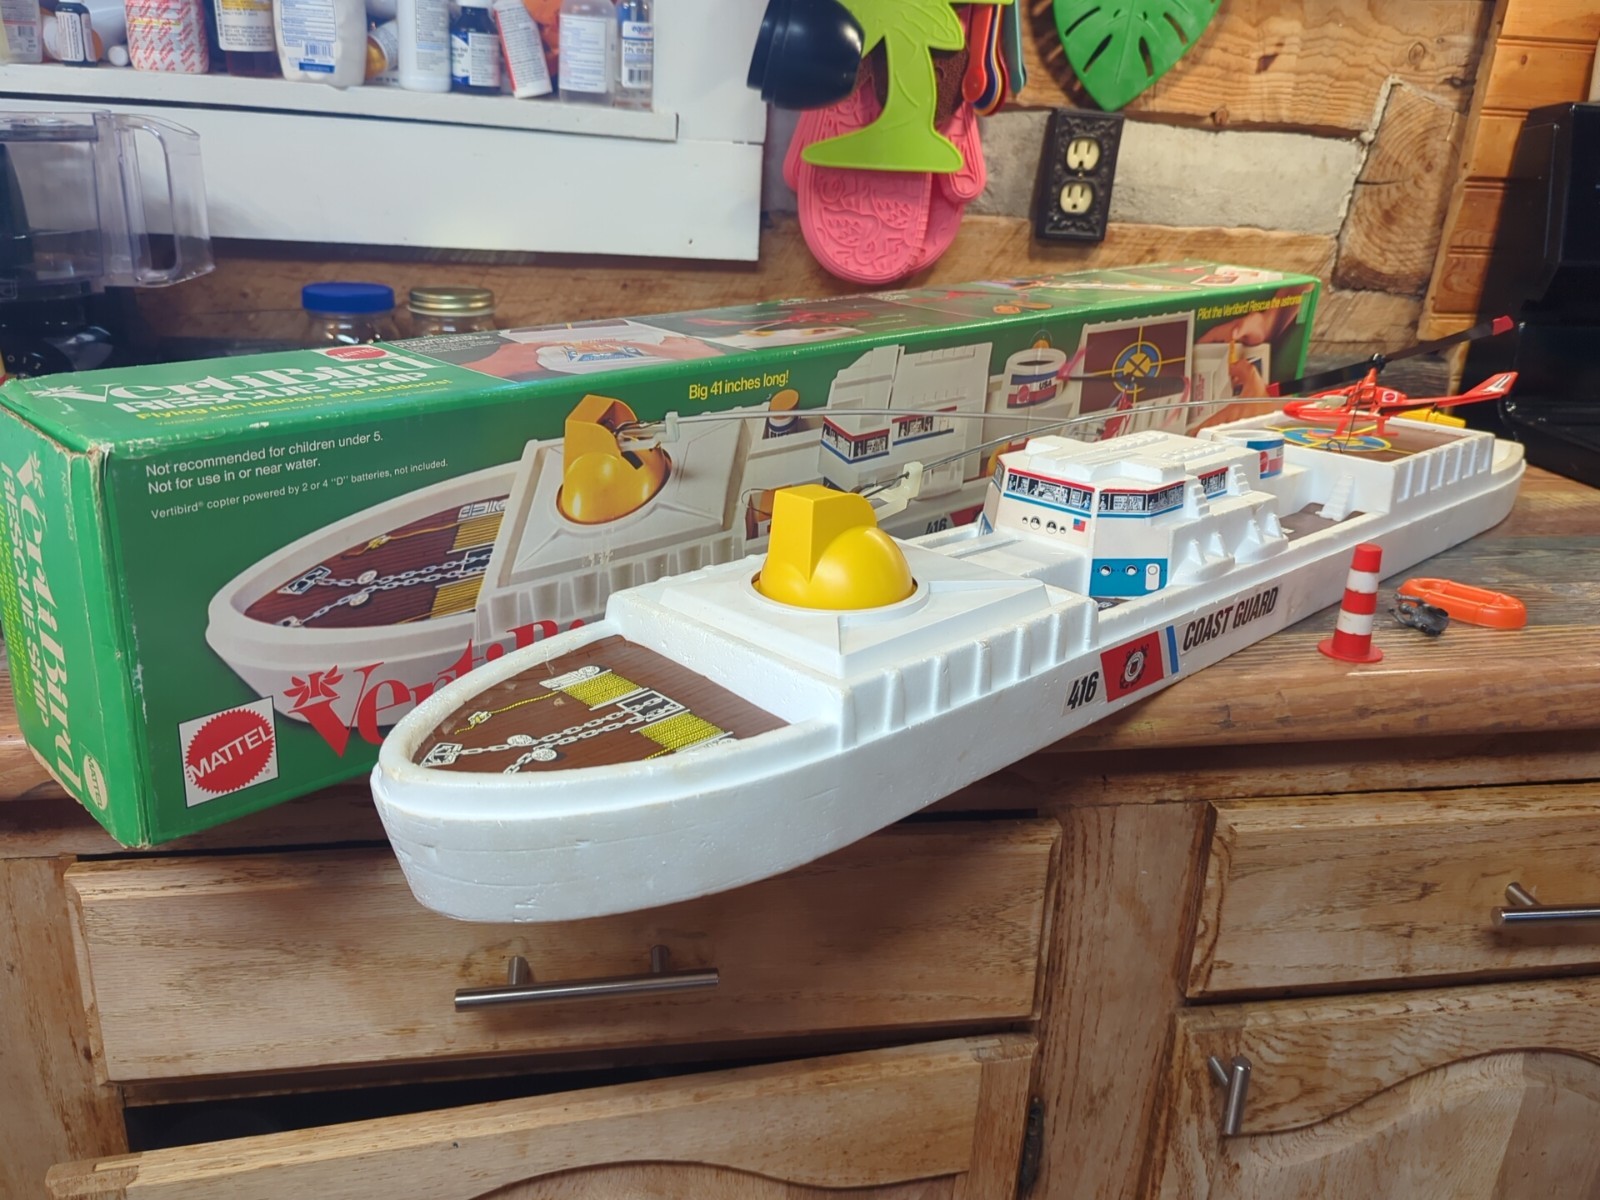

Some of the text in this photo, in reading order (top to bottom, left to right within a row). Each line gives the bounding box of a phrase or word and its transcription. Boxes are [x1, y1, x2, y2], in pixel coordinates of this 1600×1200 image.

[50, 355, 446, 403] VertiBird
[113, 383, 331, 413] RESCUE
[328, 372, 427, 390] SHIP
[136, 379, 453, 420] Flying fun indoors and outdoors!
[689, 370, 789, 401] Big 41 inches long!
[145, 431, 383, 477] Not recommended for children under 5.
[148, 457, 321, 494] Not for use in or near water.
[206, 496, 241, 509] copter
[242, 486, 286, 504] powered
[288, 484, 299, 495] by
[302, 482, 308, 492] 2
[310, 481, 320, 490] or
[322, 479, 329, 488] 4
[351, 469, 392, 484] batteries,
[394, 465, 409, 476] not
[410, 458, 449, 472] included.
[925, 517, 948, 535] 416
[1, 461, 50, 728] RESCUE SHIP
[1183, 586, 1280, 651] COAST GUARD
[16, 452, 82, 793] VertiBird
[17, 630, 33, 697] copter!
[1066, 671, 1100, 710] 416
[187, 723, 275, 782] MATTEL
[87, 753, 103, 808] MATTEL
